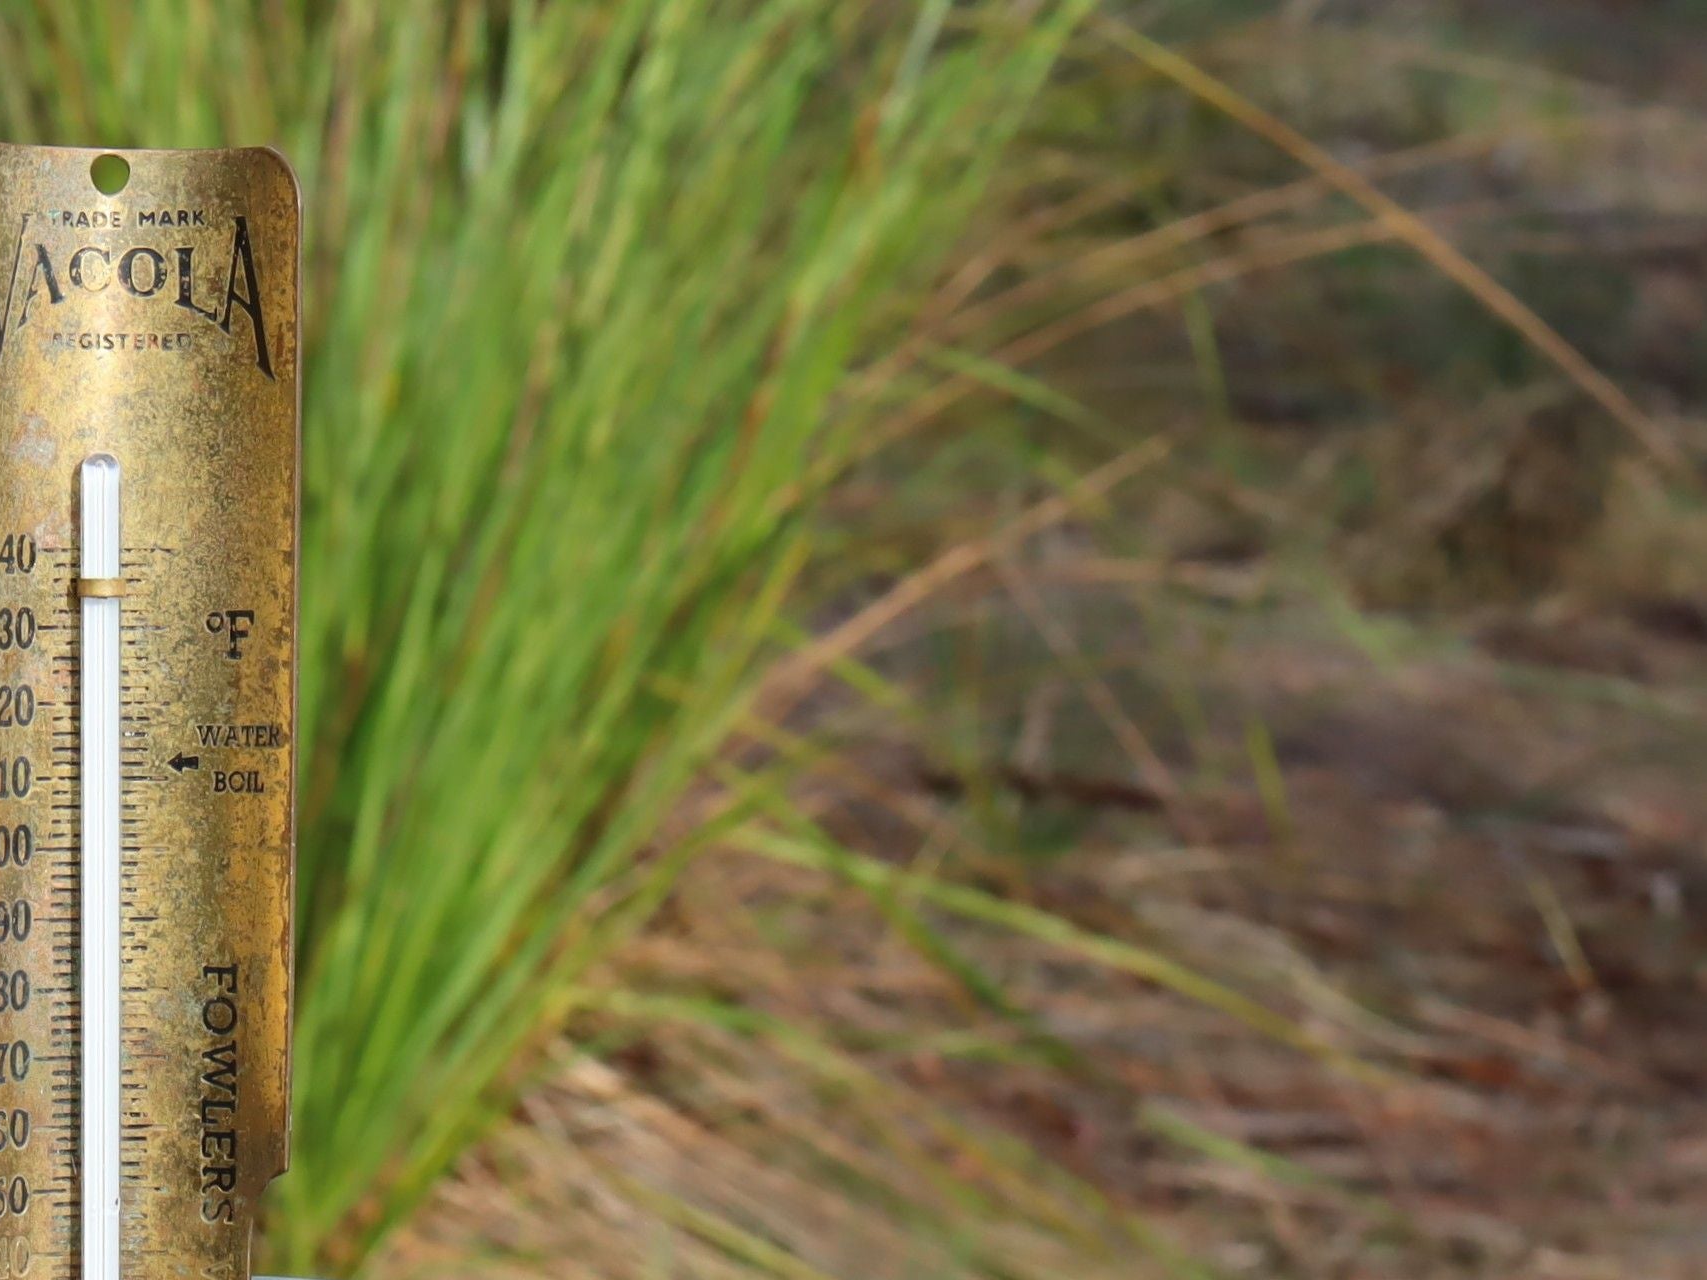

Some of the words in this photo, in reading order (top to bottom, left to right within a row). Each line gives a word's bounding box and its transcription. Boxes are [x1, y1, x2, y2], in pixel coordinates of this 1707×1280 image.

[48, 210, 122, 228] TRADE
[138, 210, 206, 227] MARK
[52, 333, 192, 350] REGISTERED
[197, 725, 282, 748] WATER
[213, 771, 265, 793] BOIL
[201, 963, 238, 1224] FOWLERS
